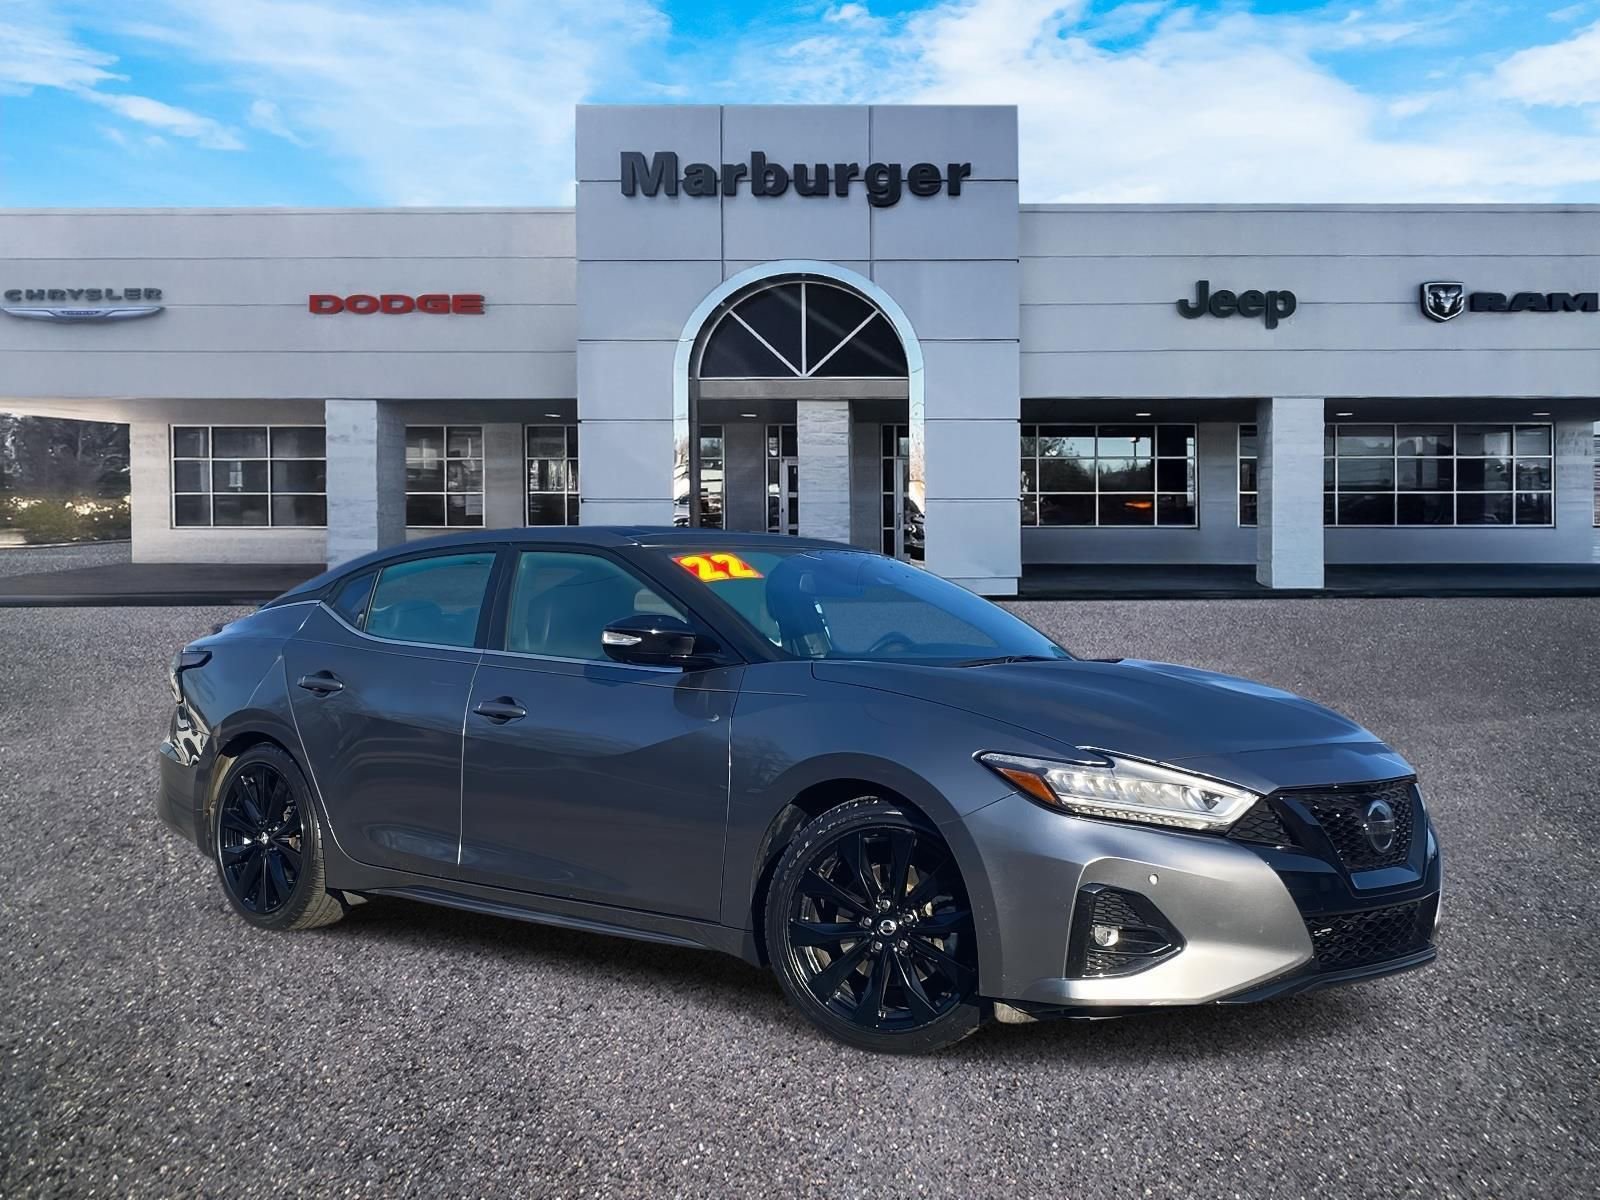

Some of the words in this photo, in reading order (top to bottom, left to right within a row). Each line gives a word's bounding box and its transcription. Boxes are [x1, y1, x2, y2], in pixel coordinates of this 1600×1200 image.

[620, 151, 972, 208] Marburger
[4, 288, 163, 301] CHRYSLER
[309, 294, 486, 315] DODGE
[1176, 280, 1297, 330] Jeep
[1469, 292, 1599, 312] RAM
[679, 553, 758, 582] 22
